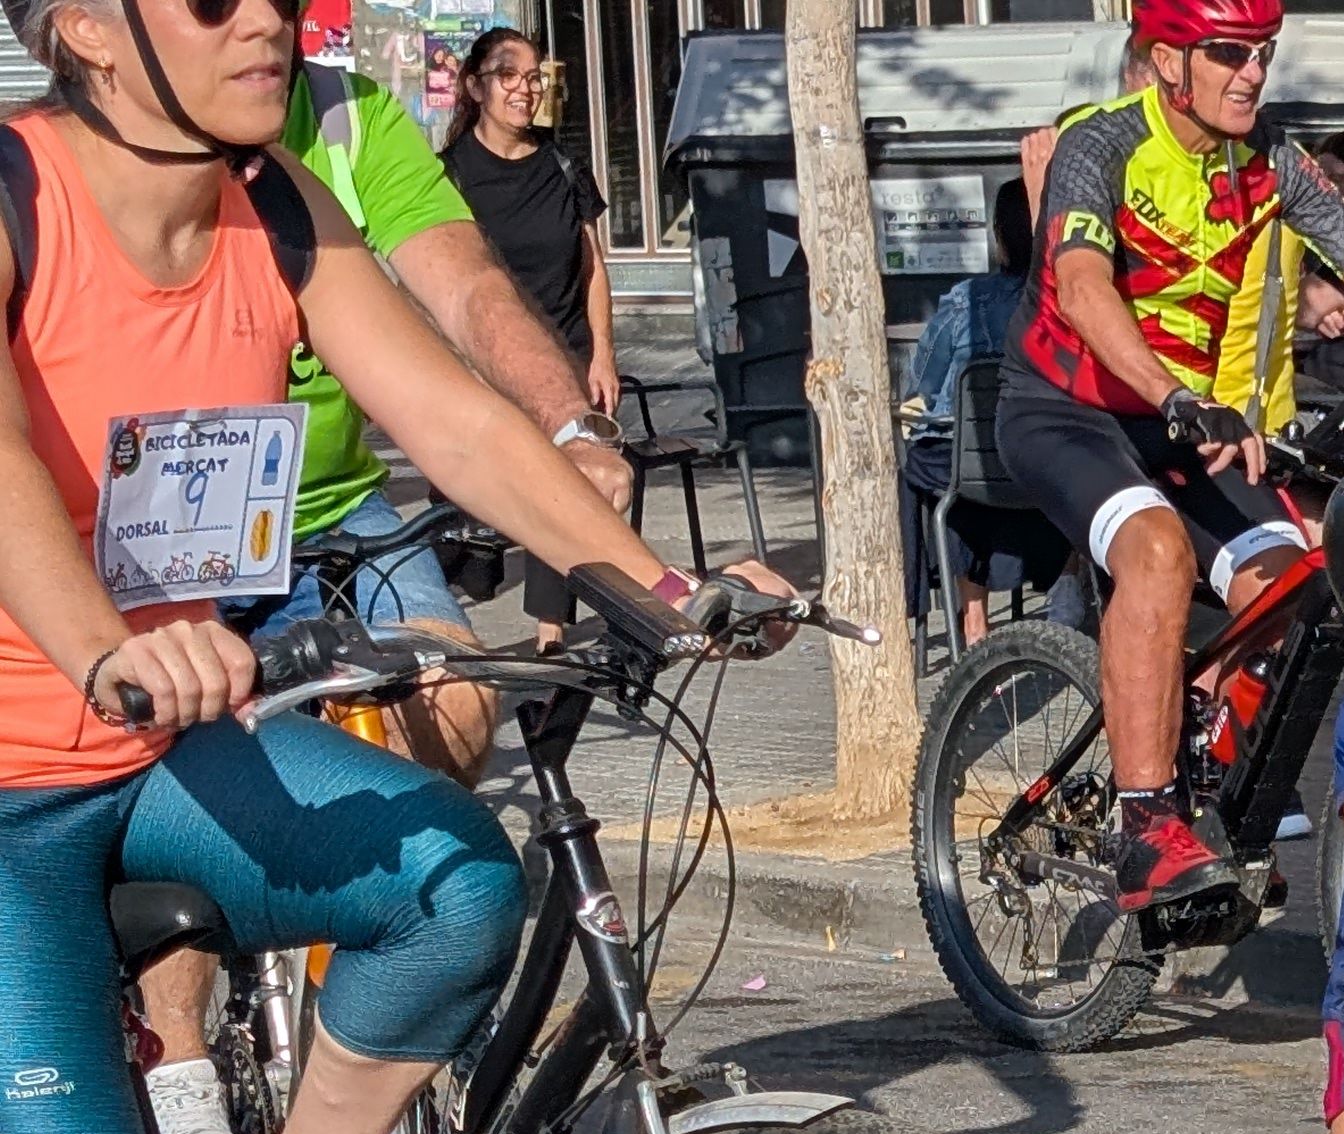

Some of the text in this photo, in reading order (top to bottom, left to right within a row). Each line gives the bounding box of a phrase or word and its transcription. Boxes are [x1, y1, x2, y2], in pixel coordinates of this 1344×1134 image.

[1131, 188, 1167, 228] FOX
[145, 430, 250, 452] BICICLETADA
[161, 458, 230, 476] MERCAT
[186, 470, 209, 526] 9
[116, 520, 169, 541] DORSAL
